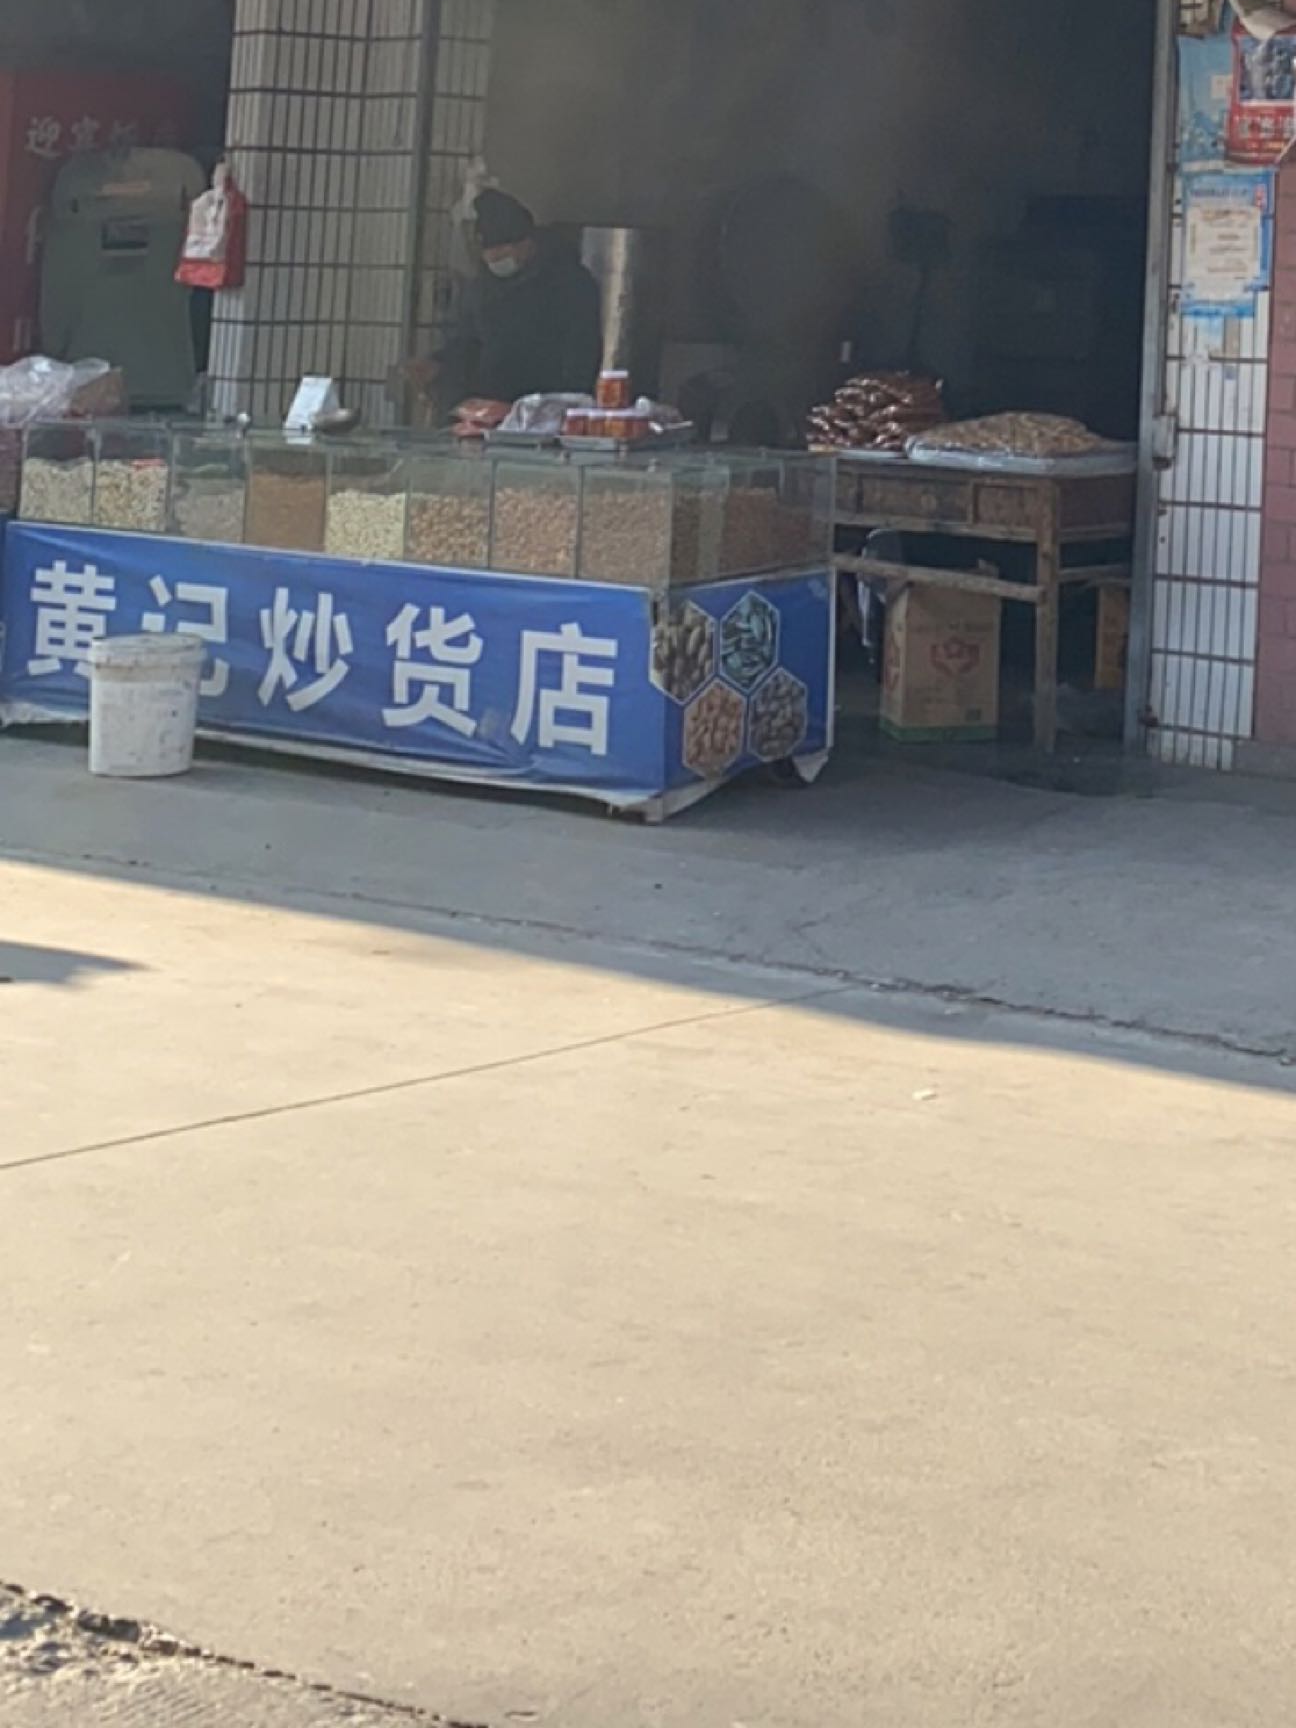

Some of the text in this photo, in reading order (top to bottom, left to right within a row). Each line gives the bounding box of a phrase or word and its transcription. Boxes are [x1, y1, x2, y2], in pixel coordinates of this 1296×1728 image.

[26, 560, 618, 757] 黄记炒货店
